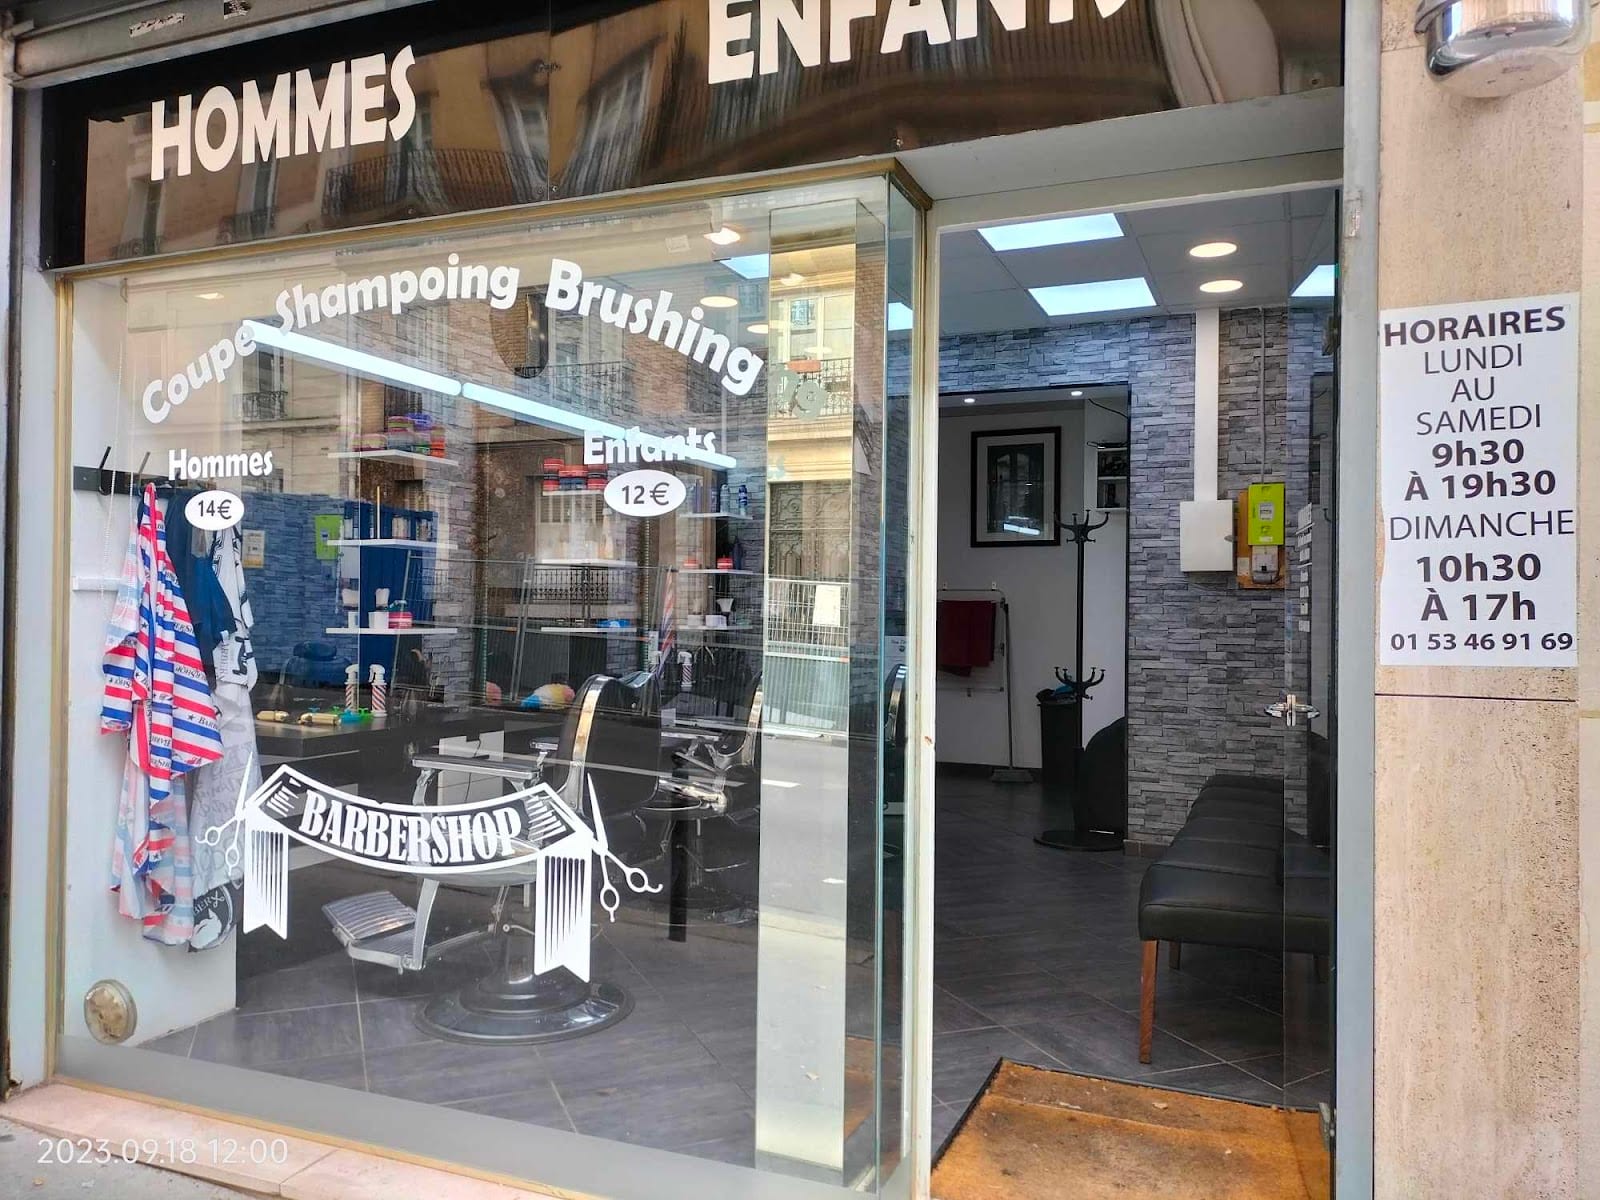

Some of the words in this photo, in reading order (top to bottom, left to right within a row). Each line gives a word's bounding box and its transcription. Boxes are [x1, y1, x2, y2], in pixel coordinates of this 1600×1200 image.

[708, 0, 1127, 85] ENFA
[150, 45, 416, 181] HOMMES
[142, 320, 257, 424] Coupe
[275, 253, 520, 336] Shampoing
[545, 258, 764, 396] Brushing
[1384, 306, 1566, 347] HORAIRES
[1424, 343, 1522, 375] LUNDI
[1450, 376, 1495, 403] AU
[1416, 404, 1541, 436] SAMEDI
[584, 426, 716, 464] Enfants
[1432, 439, 1525, 468] 9h30
[168, 449, 273, 481] Hommes
[621, 481, 670, 506] 12€
[1404, 471, 1429, 501] À
[1441, 470, 1556, 499] 19h30
[198, 499, 232, 520] 14€
[1389, 509, 1575, 541] DIMANCHE
[1416, 552, 1541, 583] 10h30
[1420, 587, 1448, 621] À
[1462, 591, 1536, 621] 17h
[1390, 633, 1417, 651] 01
[1427, 633, 1457, 651] 53
[1463, 633, 1496, 651] 46
[1502, 633, 1531, 650] 91
[1540, 632, 1573, 650] 69
[299, 789, 522, 865] BARBERSHOP
